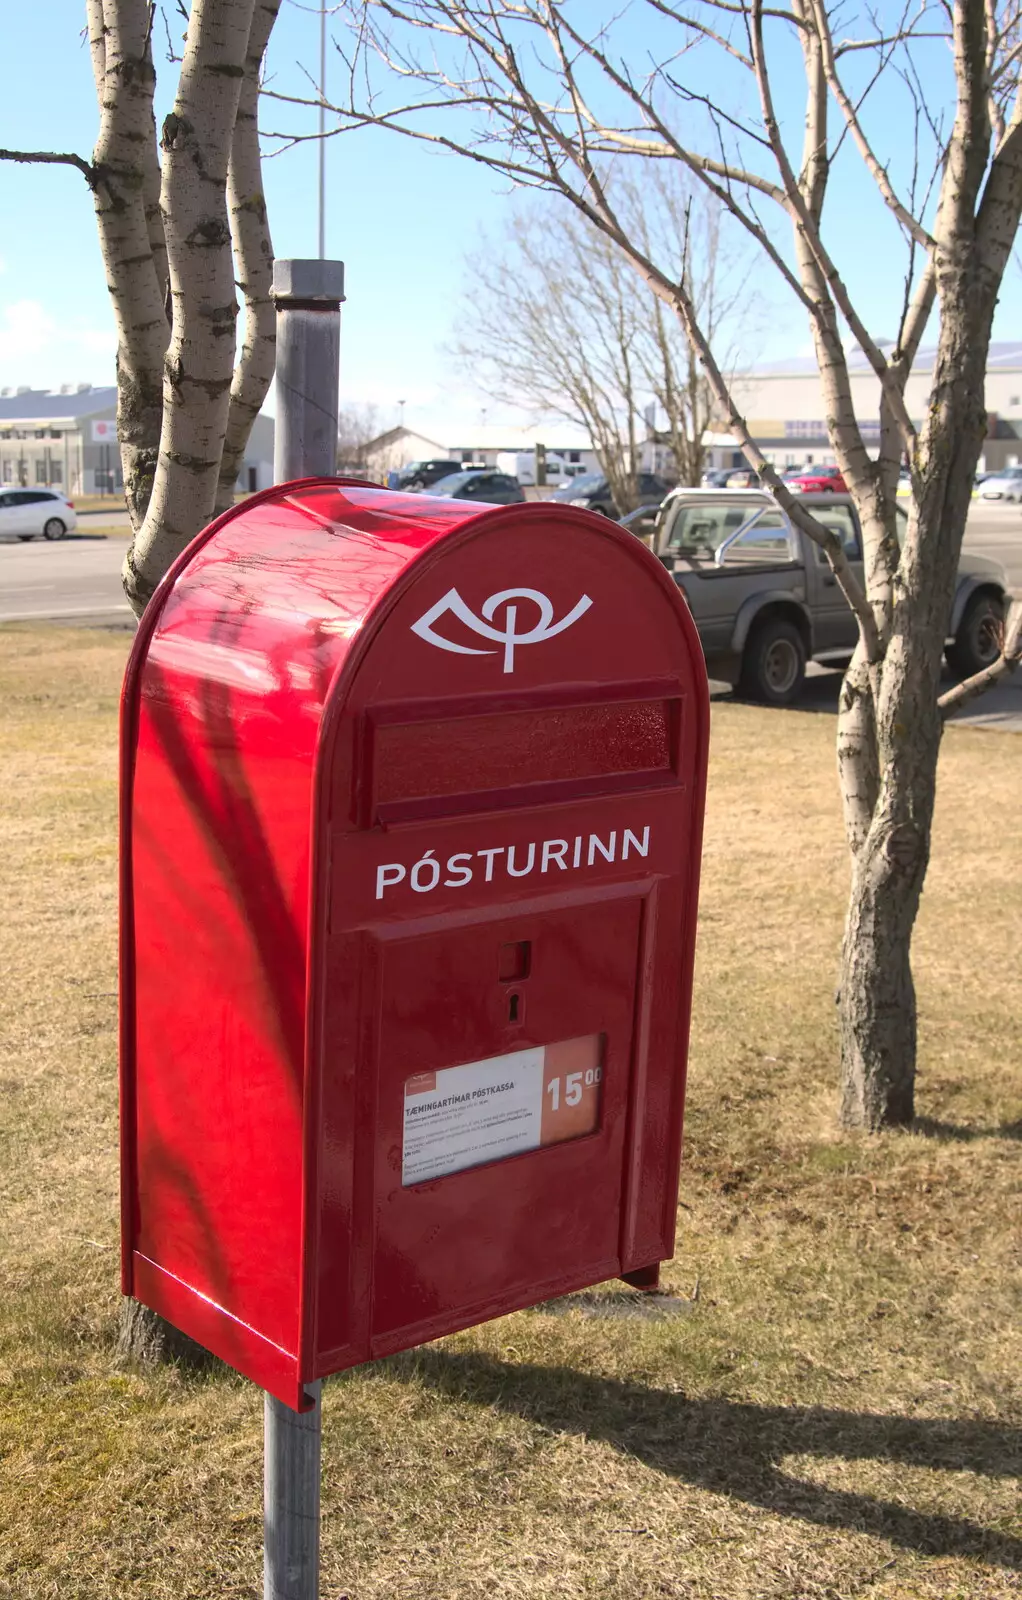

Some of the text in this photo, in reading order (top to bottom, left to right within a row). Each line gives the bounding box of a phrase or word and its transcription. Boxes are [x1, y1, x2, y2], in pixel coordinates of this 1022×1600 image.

[375, 826, 650, 900] PÓSTURINN
[405, 1092, 471, 1117] TÆMINGARTÍMAR
[472, 1081, 515, 1100] PÓSTKASSA
